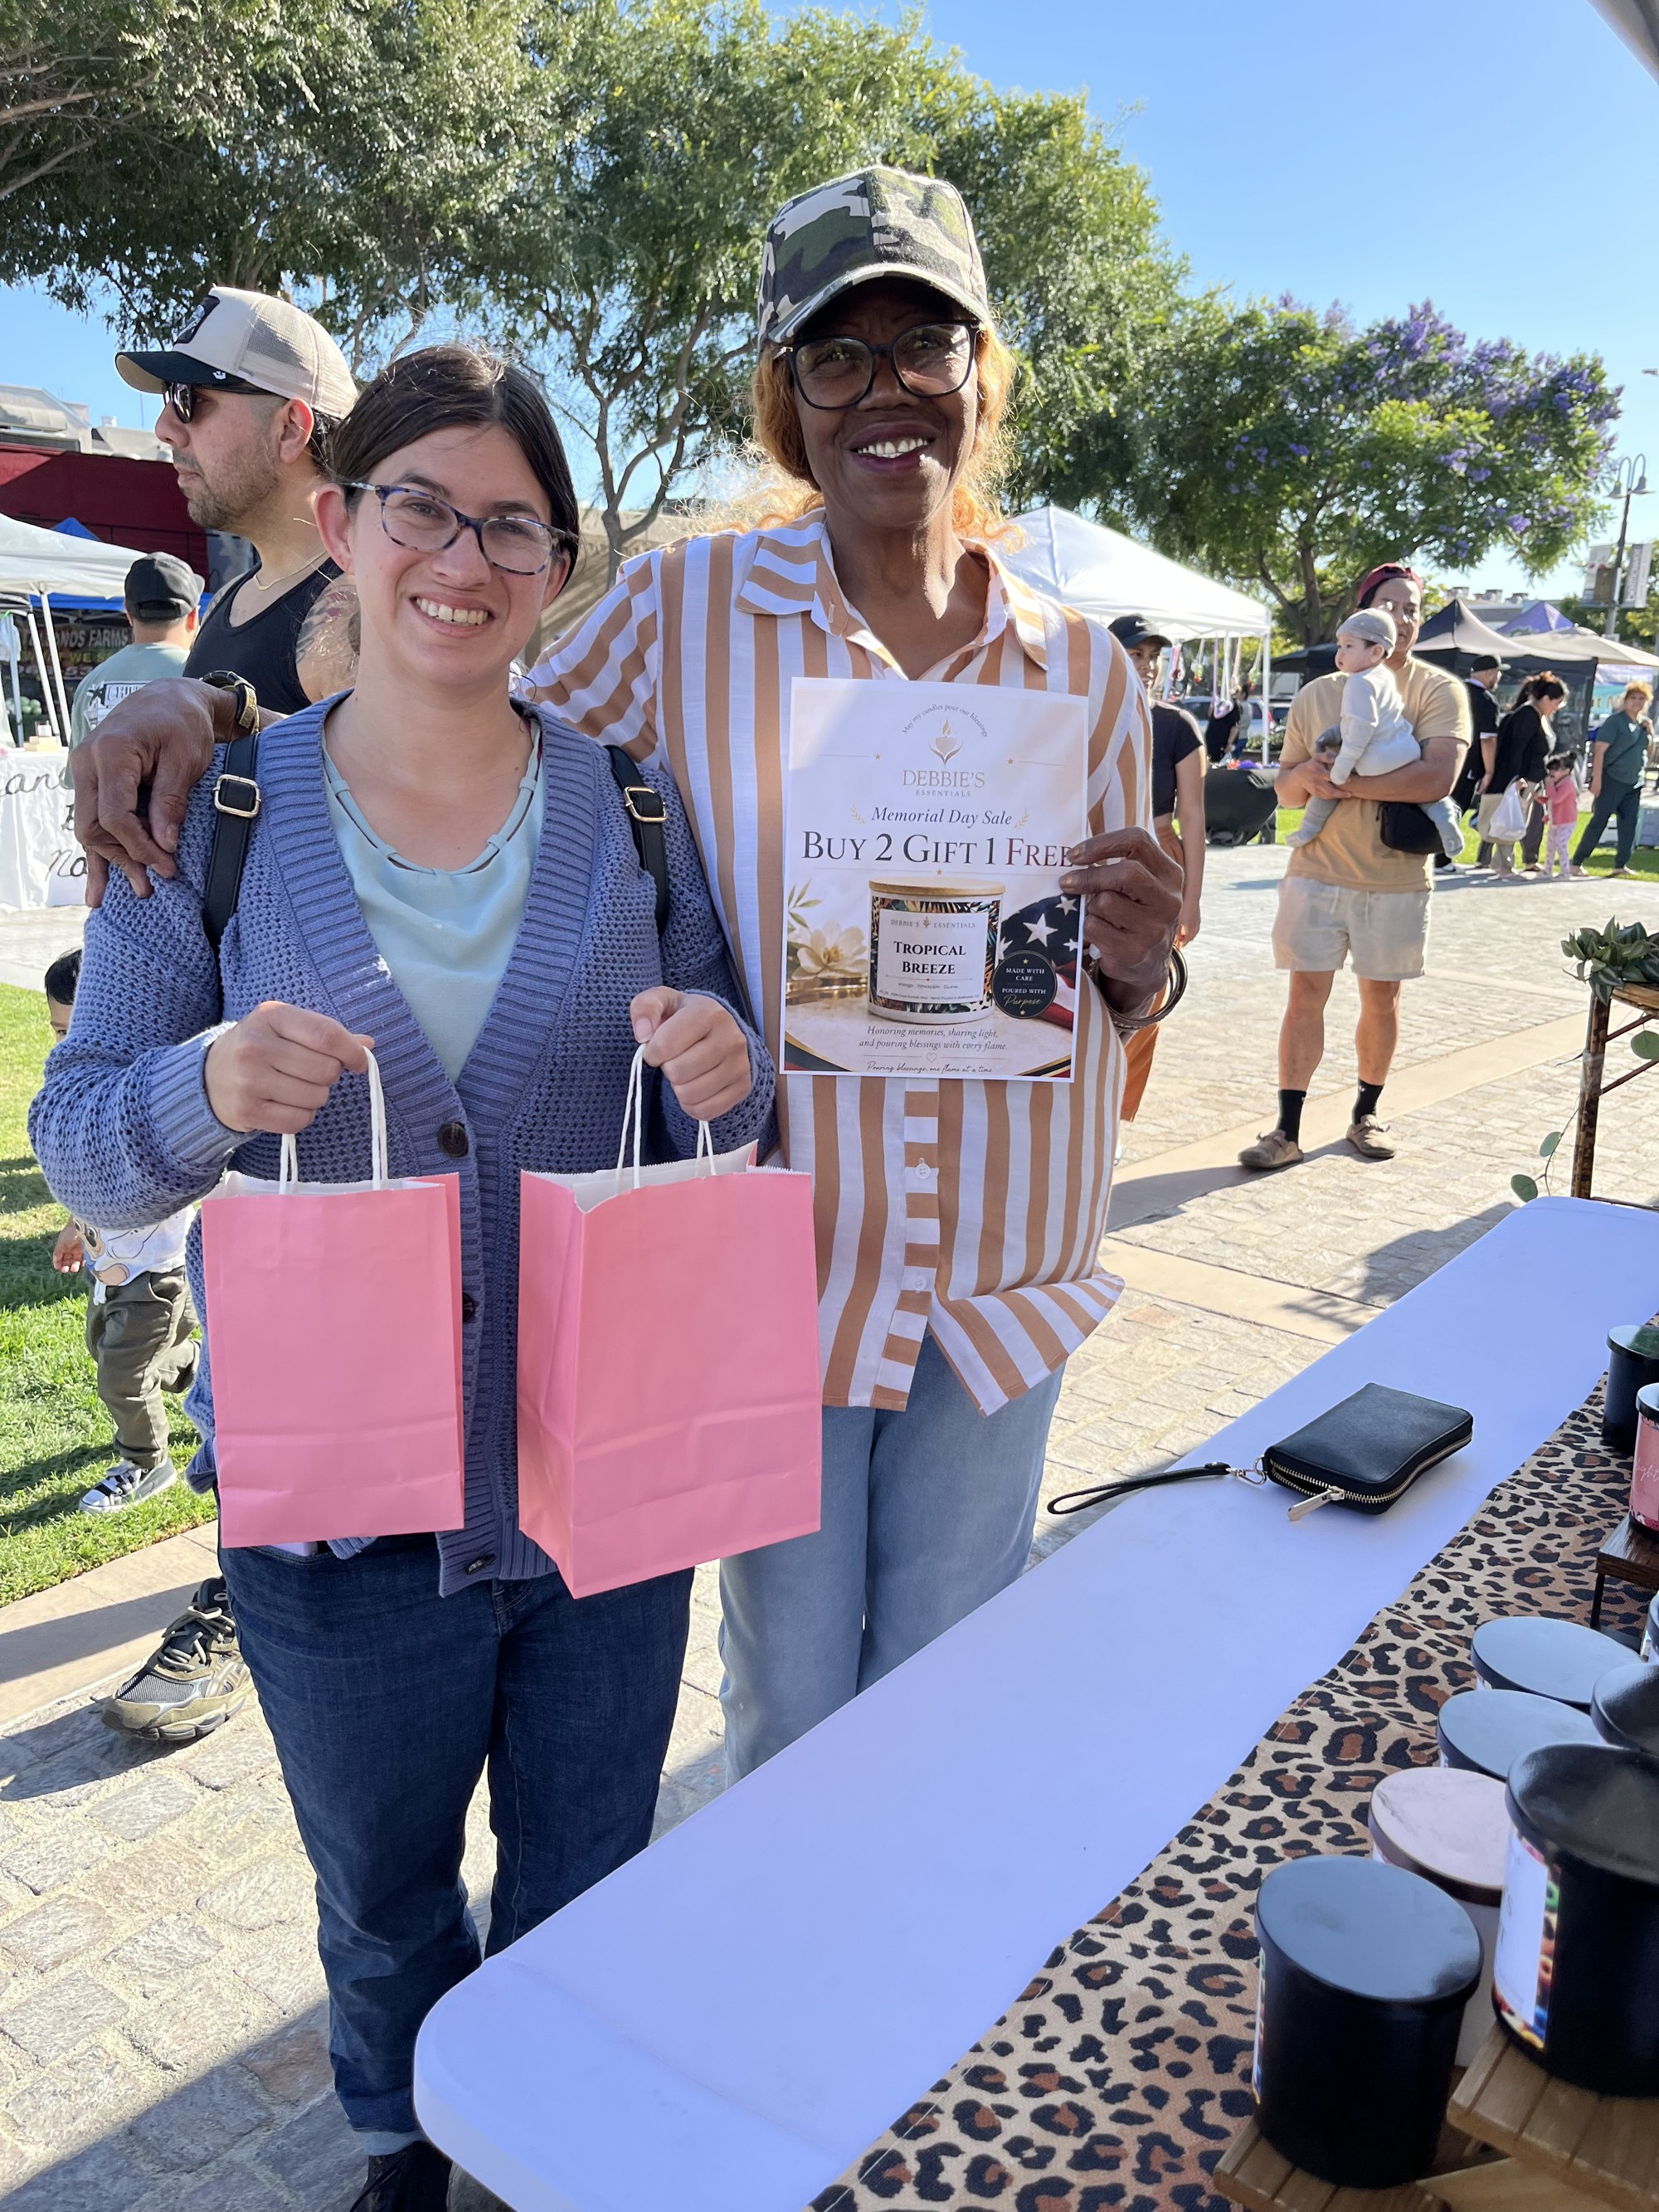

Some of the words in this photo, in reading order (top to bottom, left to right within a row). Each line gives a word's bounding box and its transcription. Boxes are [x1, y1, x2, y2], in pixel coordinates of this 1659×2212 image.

[88, 628, 129, 648] FARMS
[902, 721, 914, 734] May
[922, 704, 943, 715] candles
[970, 713, 988, 737] blessings
[902, 769, 985, 788] DEBBIE'S
[916, 789, 971, 797] ESSENTIALS
[871, 806, 943, 823] Memorial
[948, 808, 978, 828] Day
[982, 810, 1012, 826] Sale
[874, 833, 893, 862] 2
[985, 837, 995, 865] 1
[890, 918, 920, 928] DEBBIE'S
[1003, 993, 1042, 1010] Purpose
[867, 1026, 907, 1038] Honoring
[907, 1029, 946, 1037] memories,
[947, 1028, 977, 1039] sharing
[979, 1028, 998, 1039] light,
[859, 1039, 874, 1047] and
[875, 1040, 907, 1050] pouring
[909, 1039, 941, 1050] blessings
[943, 1040, 961, 1049] with
[961, 1042, 982, 1051] every
[983, 1040, 1008, 1051] flame.
[866, 1060, 894, 1073] Pouring
[941, 1065, 960, 1074] flame
